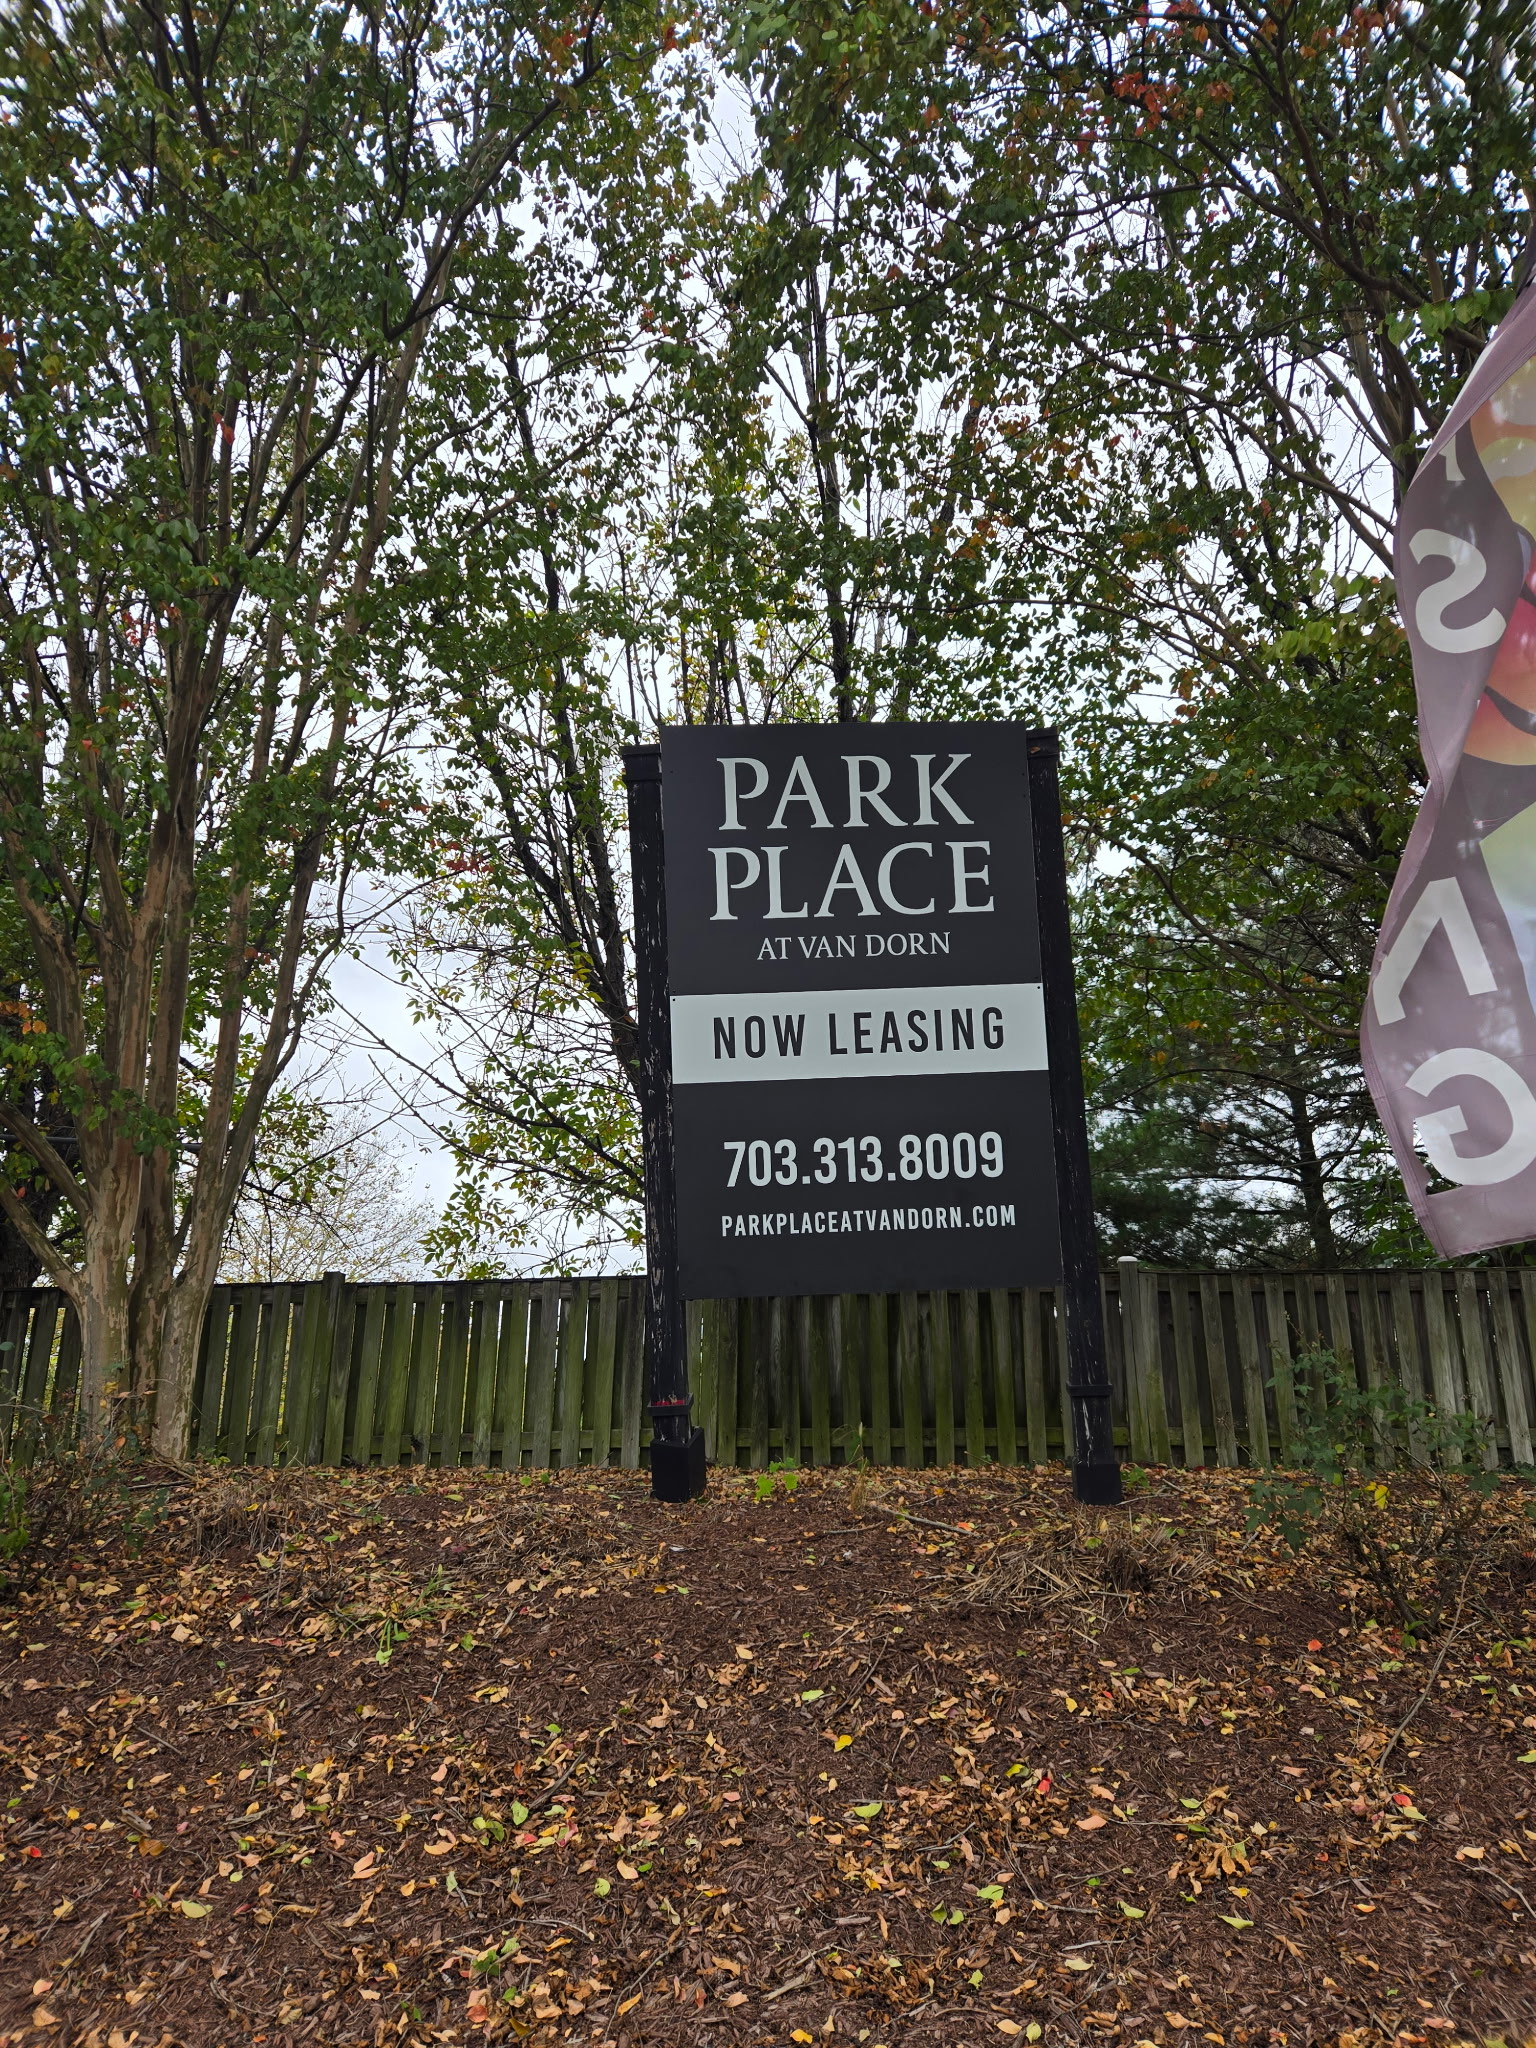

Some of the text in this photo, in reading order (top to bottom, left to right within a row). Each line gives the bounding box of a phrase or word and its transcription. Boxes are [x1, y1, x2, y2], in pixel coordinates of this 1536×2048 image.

[716, 753, 975, 831] PARK
[707, 840, 995, 921] PLACE
[756, 931, 951, 961] AT VAN DORN
[713, 1006, 1004, 1060] NOW LEASING
[723, 1131, 1004, 1188] 703.313.8009
[721, 1204, 1016, 1237] PARKPLACEATVANDORN.COM
